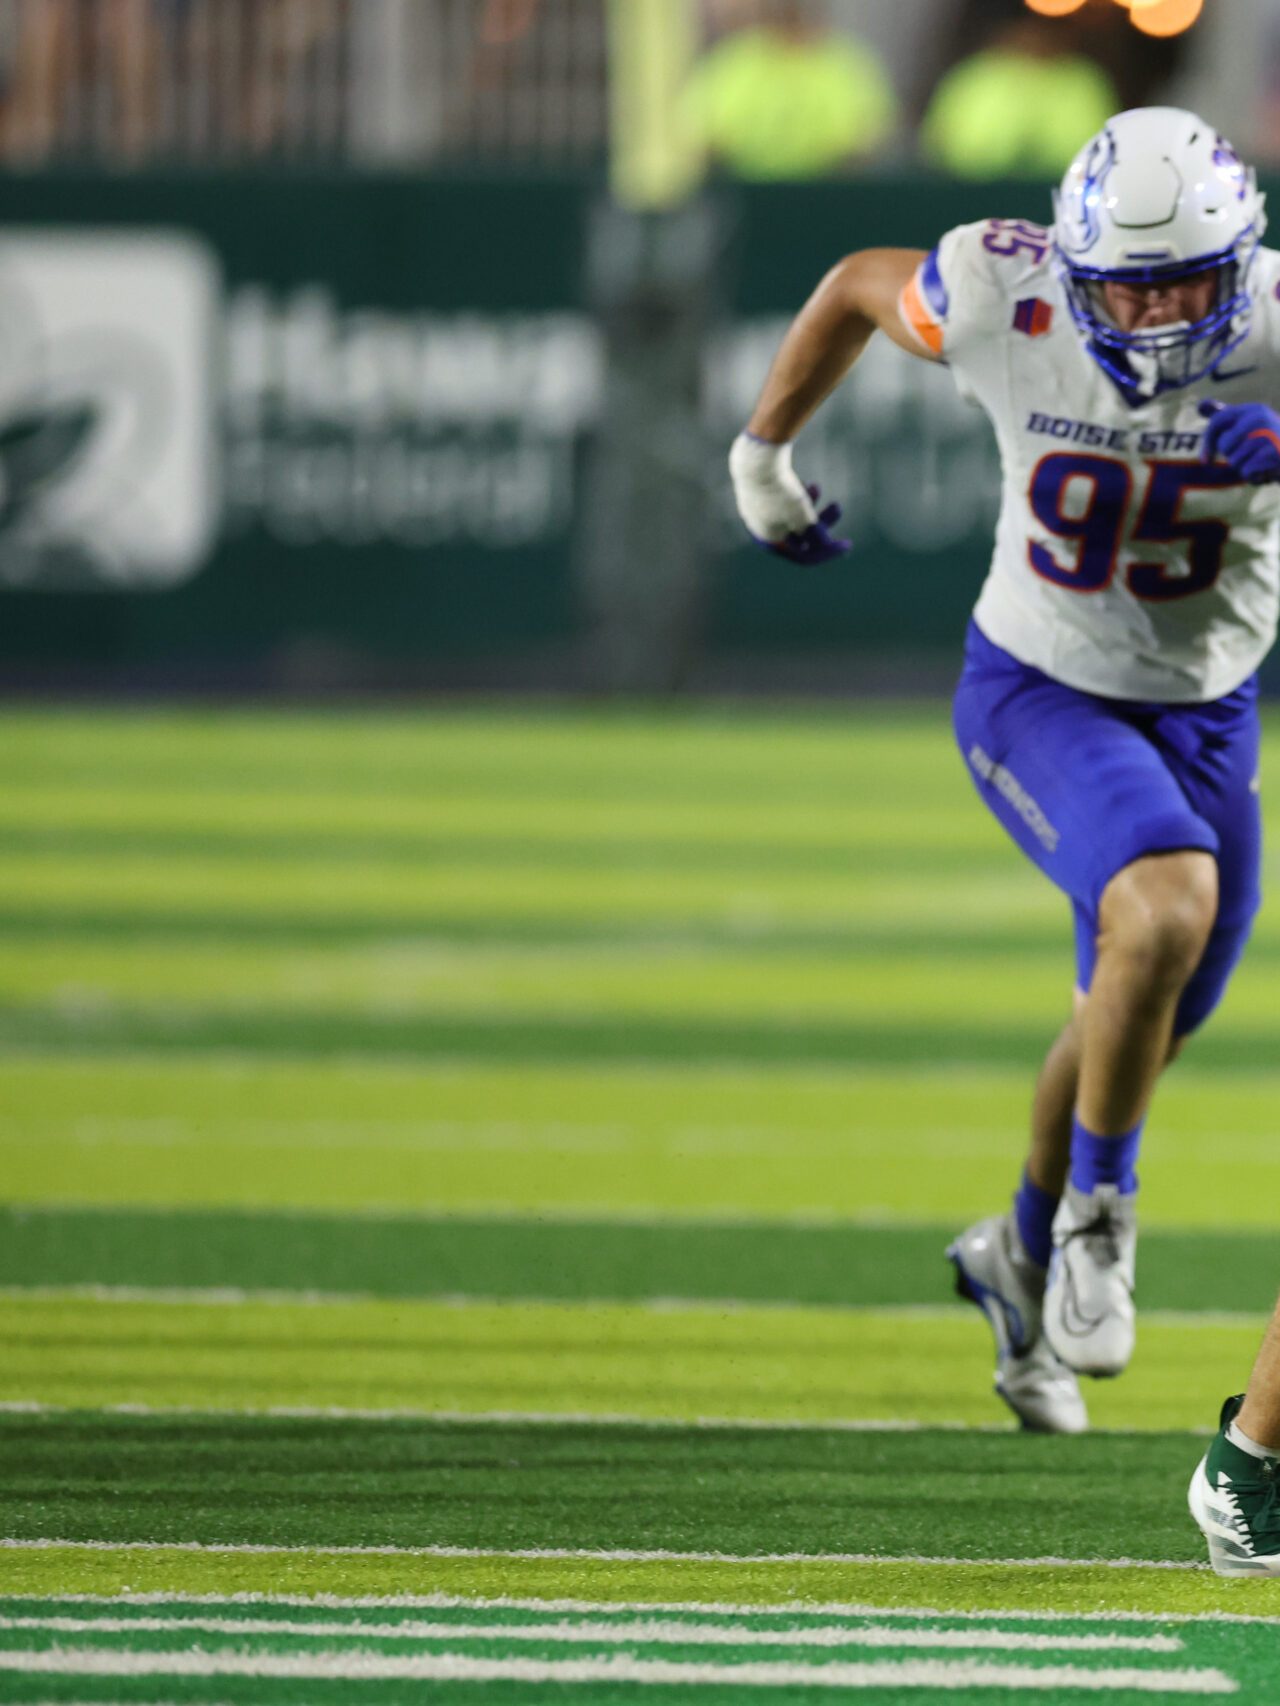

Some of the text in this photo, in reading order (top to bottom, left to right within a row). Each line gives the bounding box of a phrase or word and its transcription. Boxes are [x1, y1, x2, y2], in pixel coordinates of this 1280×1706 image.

[1026, 411, 1203, 455] BOISE STA
[1027, 451, 1248, 602] 95
